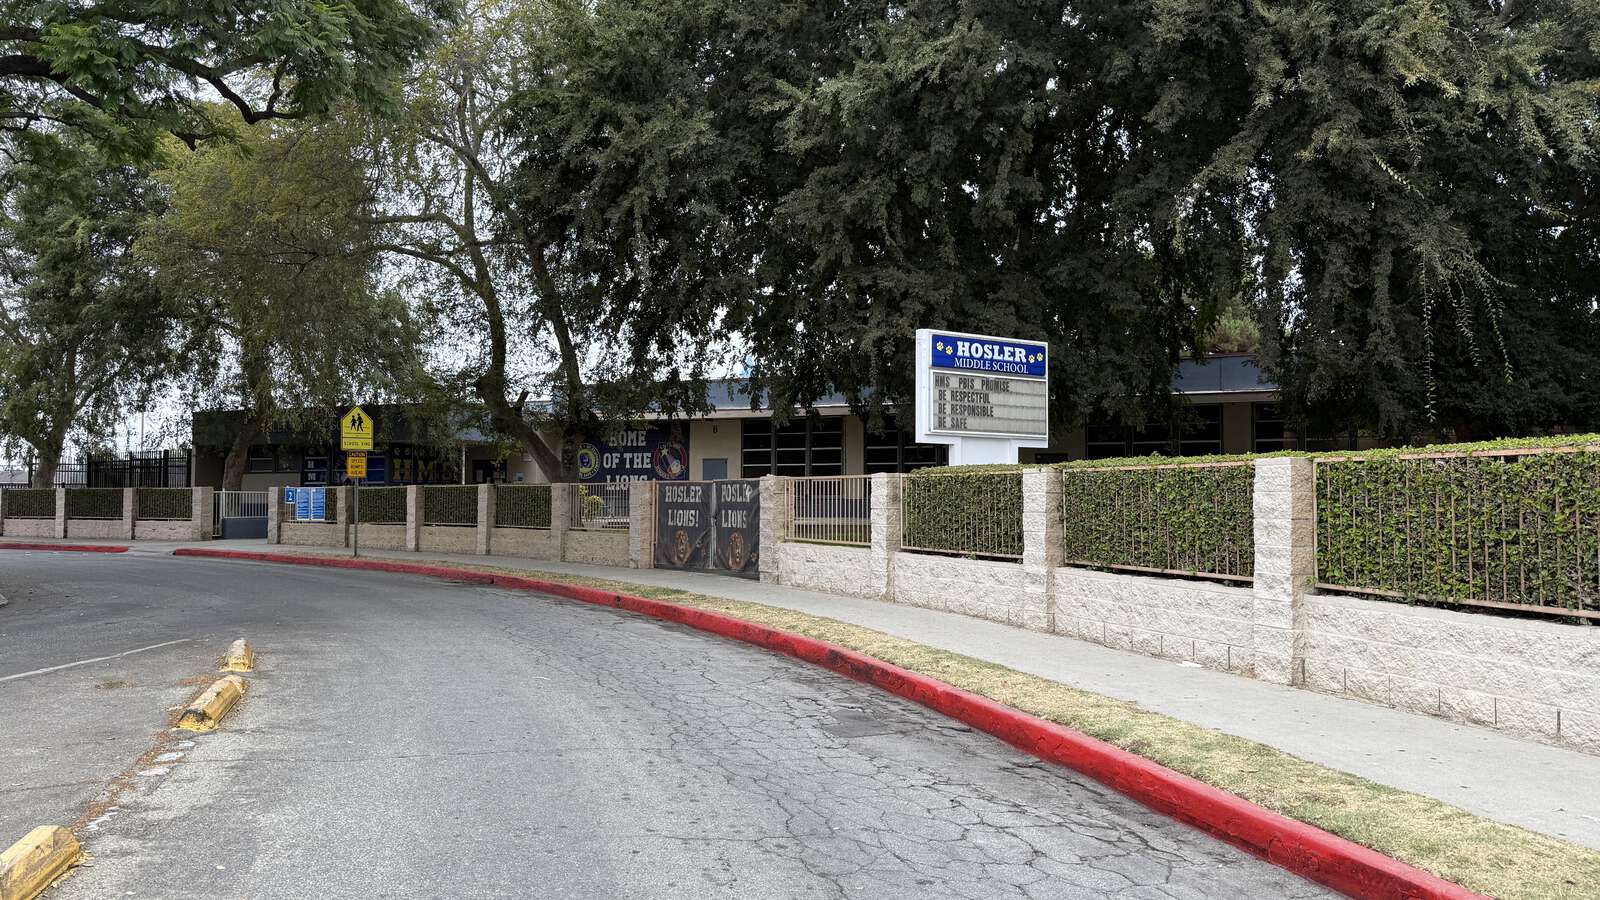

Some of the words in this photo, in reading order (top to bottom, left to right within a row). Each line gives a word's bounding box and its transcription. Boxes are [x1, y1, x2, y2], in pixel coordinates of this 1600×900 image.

[956, 340, 1027, 363] HOSLER
[954, 357, 991, 370] MIDDLE
[992, 361, 1029, 374] SCHOOL
[935, 376, 951, 388] HMS
[958, 377, 975, 390] PBIS
[981, 379, 1010, 392] PROMISE
[938, 389, 947, 401] BE
[950, 390, 991, 404] RESPECTFUL
[938, 403, 947, 415] BE
[950, 404, 994, 417] RESPONSIBLE
[938, 417, 947, 428] BE
[950, 418, 968, 429] SAFE
[609, 430, 647, 447] HOME
[603, 452, 621, 469] OF
[623, 452, 652, 469] THE
[665, 485, 702, 503] HOSLER
[668, 509, 699, 527] LIONS!
